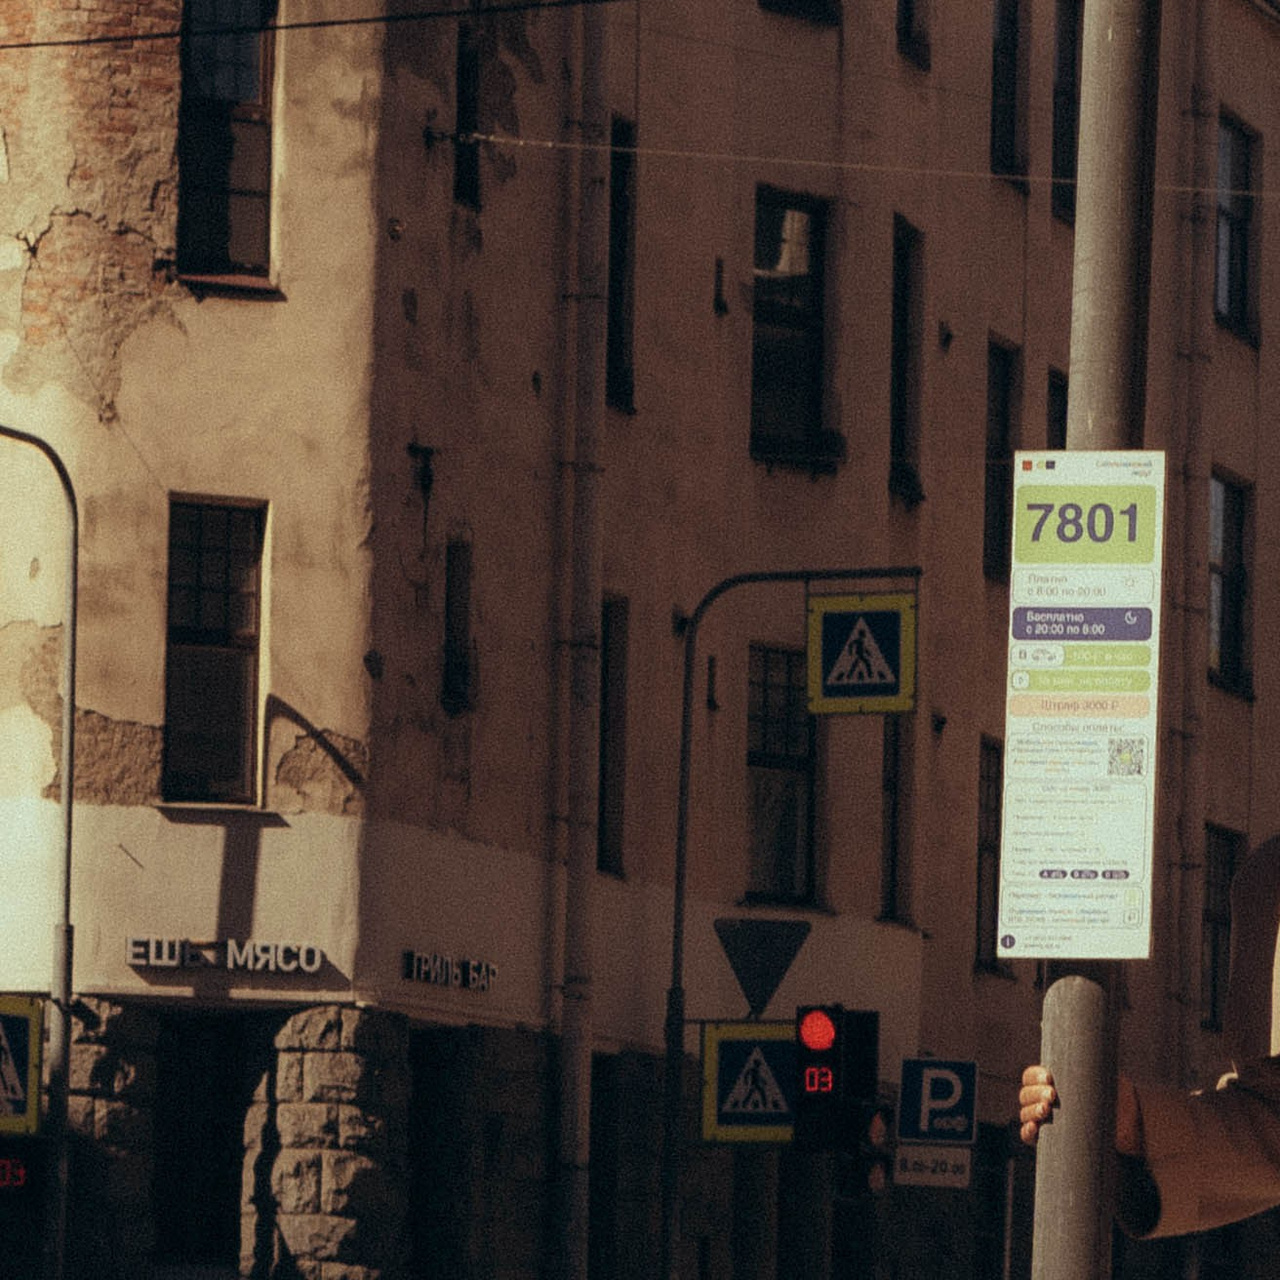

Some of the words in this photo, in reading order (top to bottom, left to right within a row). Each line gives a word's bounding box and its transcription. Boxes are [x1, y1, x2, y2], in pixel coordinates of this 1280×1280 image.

[1026, 502, 1138, 543] 7801
[1026, 611, 1085, 623] Бесплатно
[1035, 623, 1065, 635] 20:00
[1066, 625, 1080, 635] по
[1041, 700, 1080, 712] Штраф
[1082, 700, 1109, 711] 3000
[226, 938, 323, 973] МЯСО
[413, 952, 462, 988] ГРИЛЬ
[469, 959, 500, 993] БАР
[805, 1066, 833, 1092] 03
[920, 1067, 963, 1133] P
